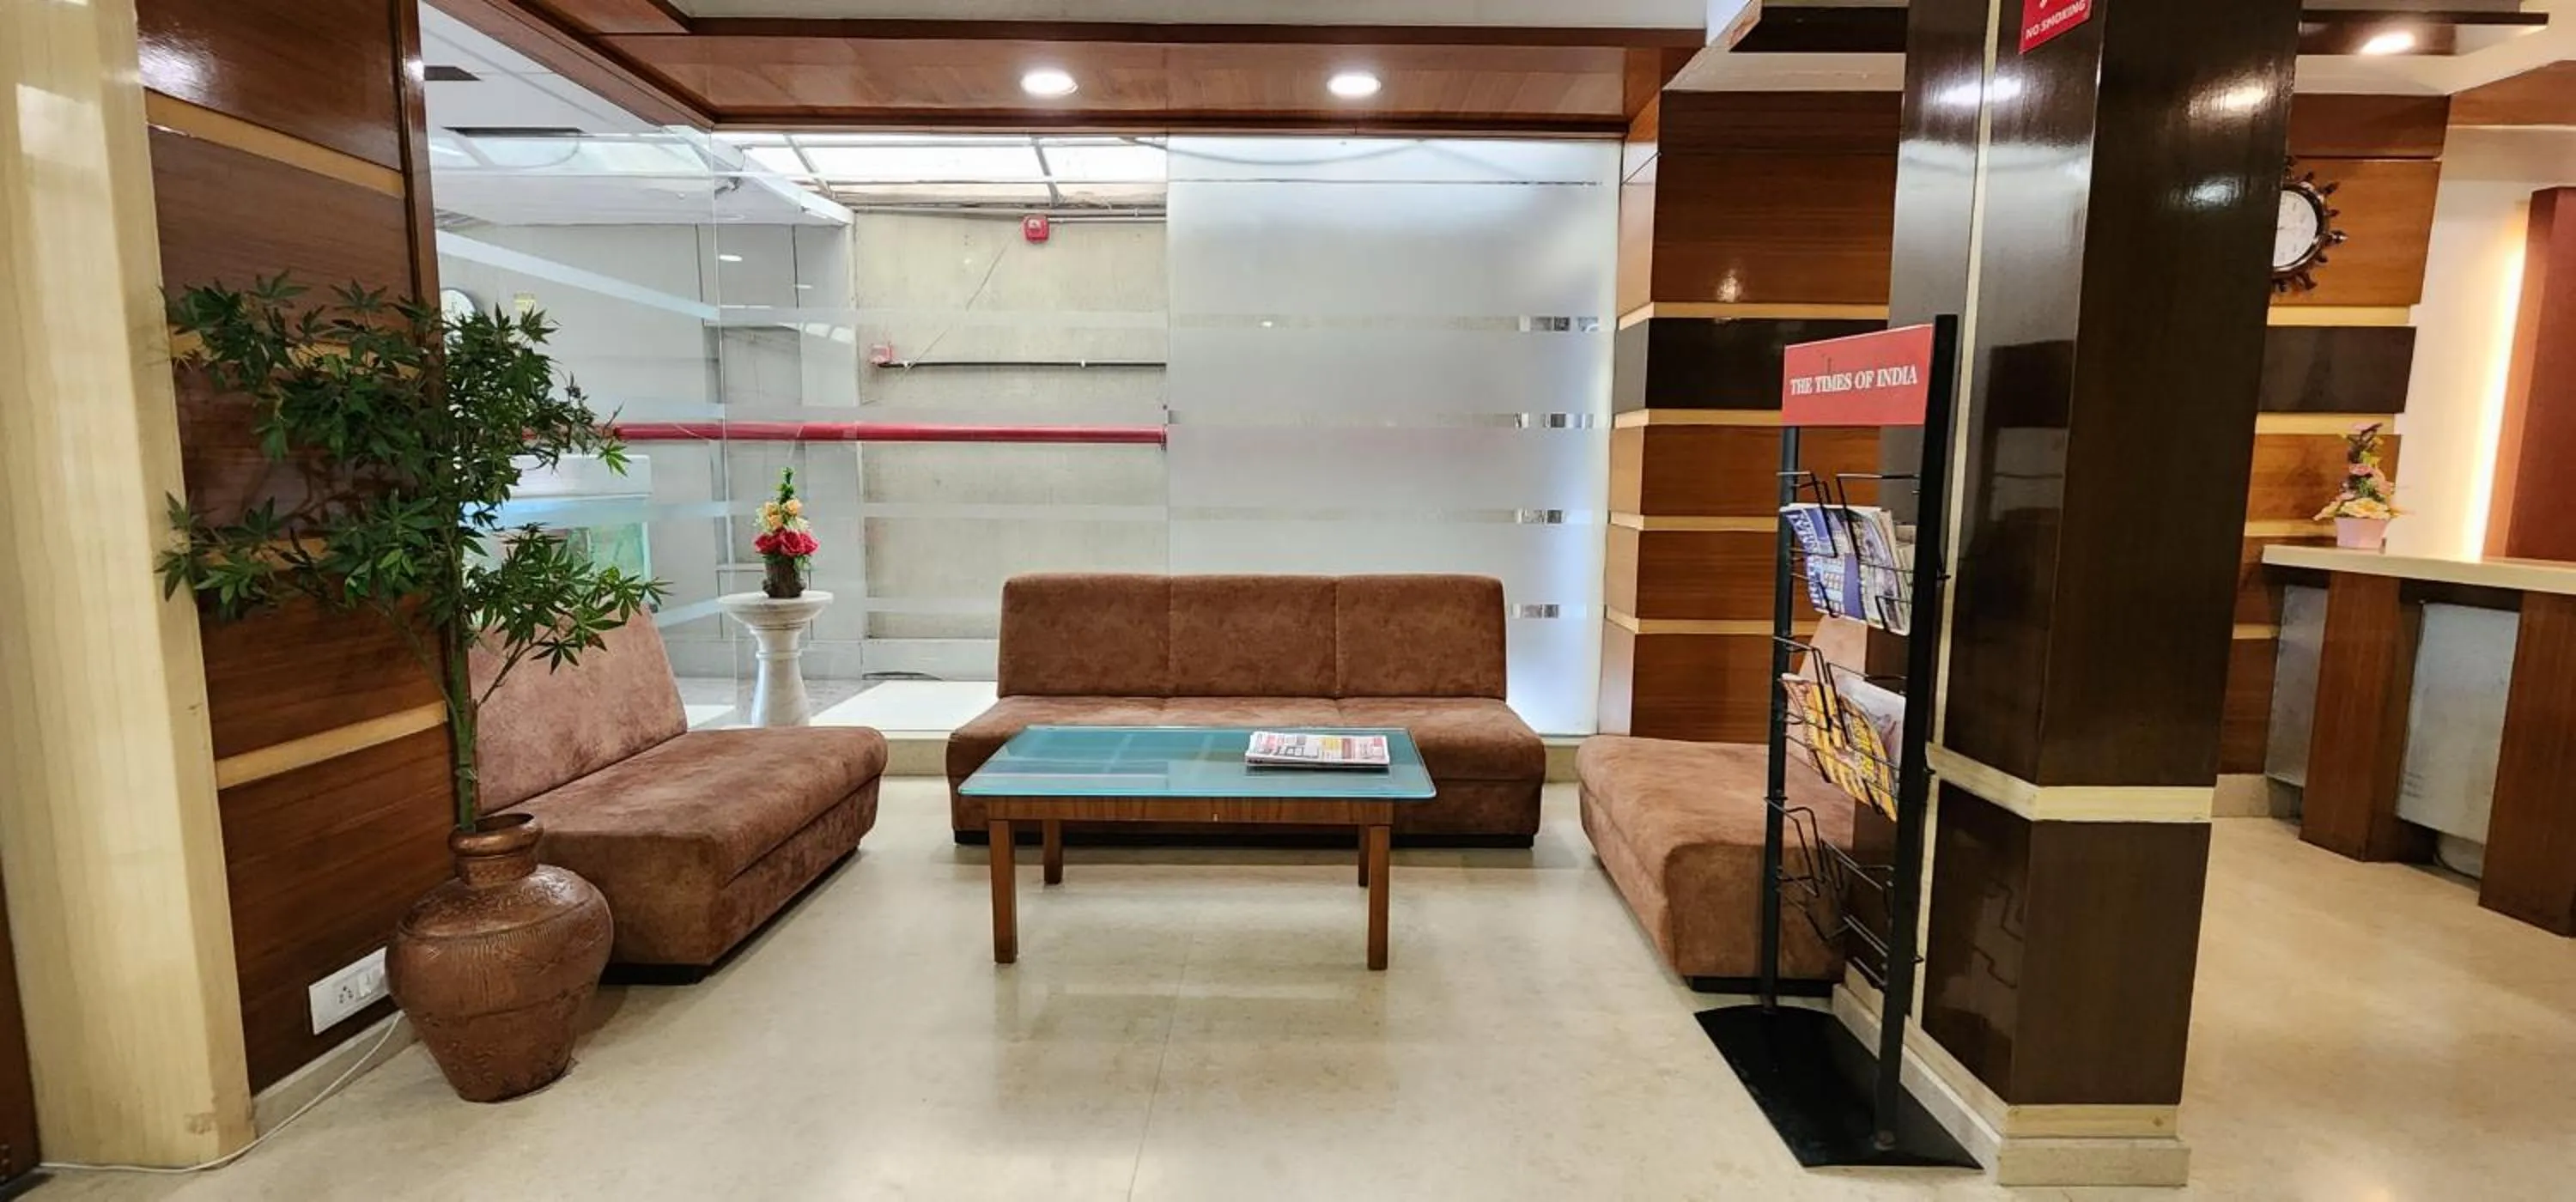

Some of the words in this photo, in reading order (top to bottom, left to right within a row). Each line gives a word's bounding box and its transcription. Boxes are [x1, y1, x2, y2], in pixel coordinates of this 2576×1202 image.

[2026, 24, 2039, 39] NO
[2040, 0, 2086, 32] SMOKING
[1790, 378, 1813, 395] THE
[1814, 373, 1852, 392] TIMES
[1855, 370, 1874, 389] OF
[1877, 364, 1917, 387] INDIA
